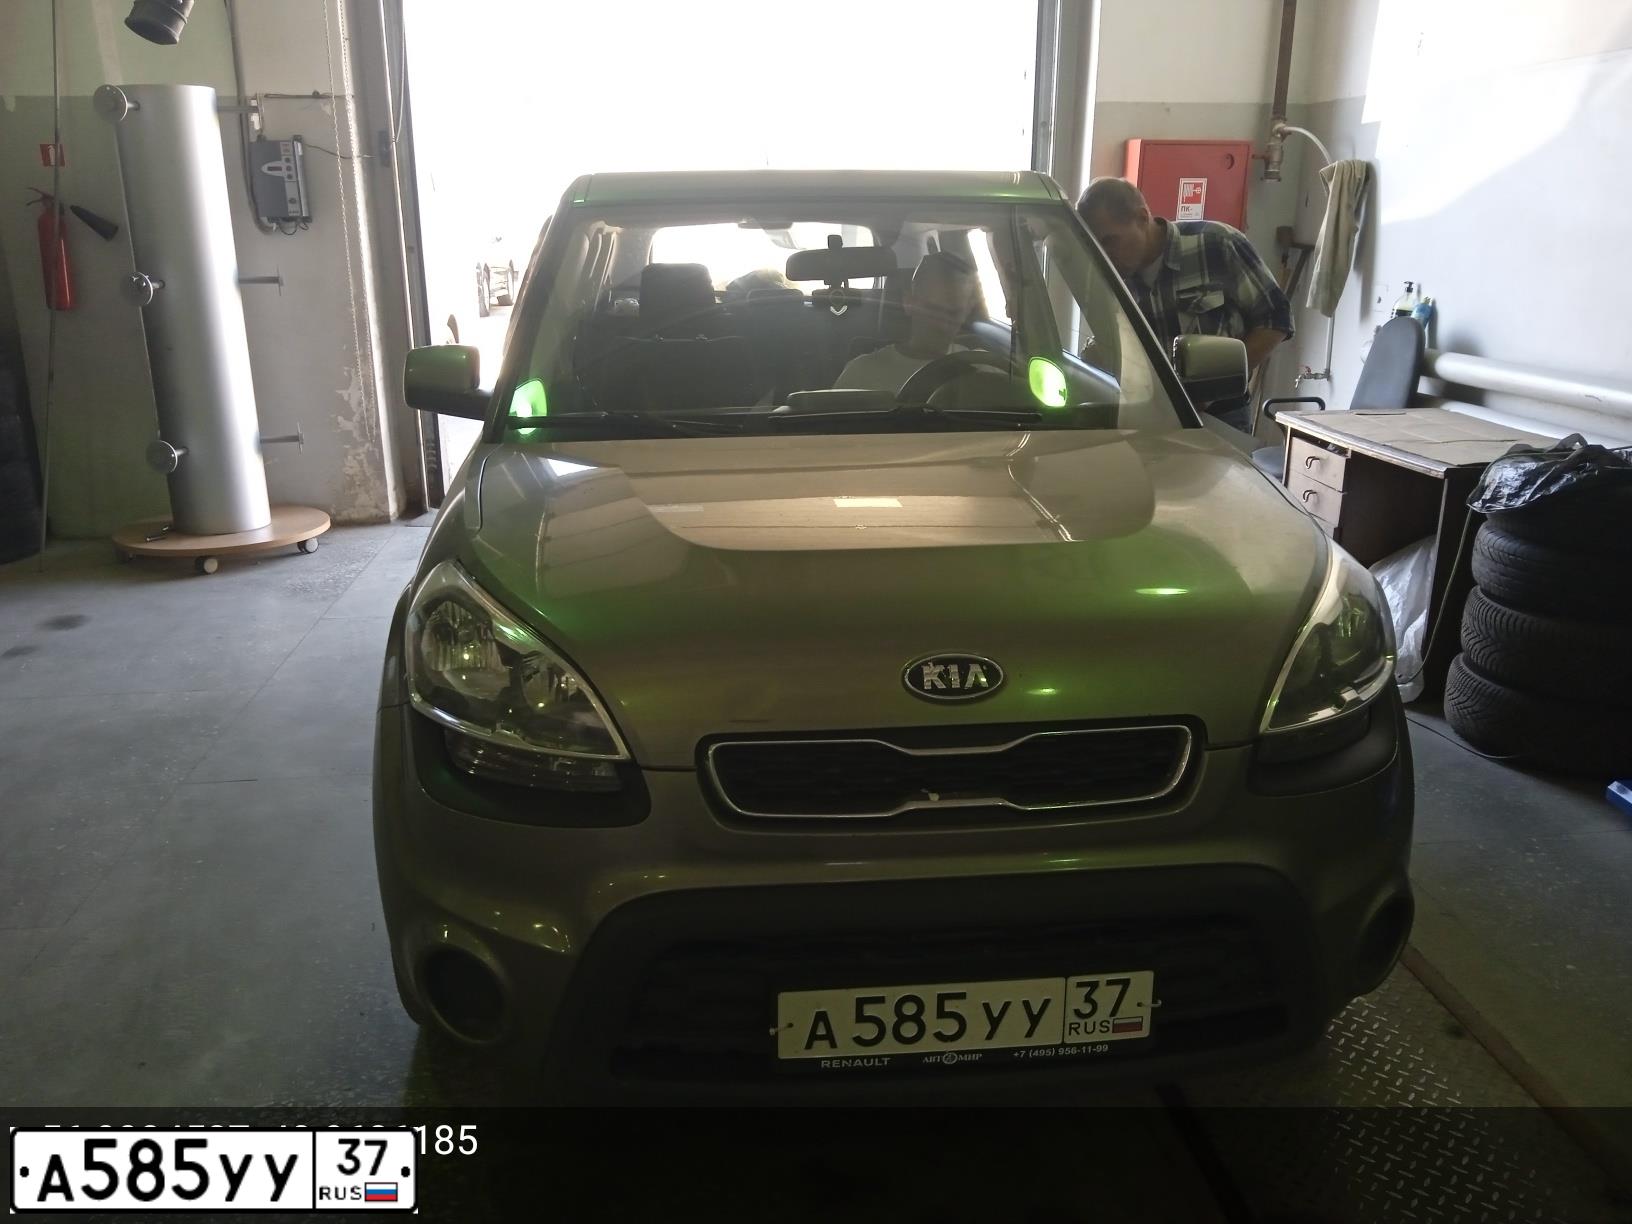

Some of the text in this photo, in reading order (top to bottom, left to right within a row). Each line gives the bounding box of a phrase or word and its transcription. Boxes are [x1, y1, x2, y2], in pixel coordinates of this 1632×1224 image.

[922, 663, 989, 690] KIA
[1073, 978, 1131, 1020] 37
[1068, 1019, 1111, 1036] RUS
[1028, 1047, 1056, 1058] (495)
[1058, 1043, 1109, 1056] 956-11-99
[820, 1056, 891, 1069] RENAULT
